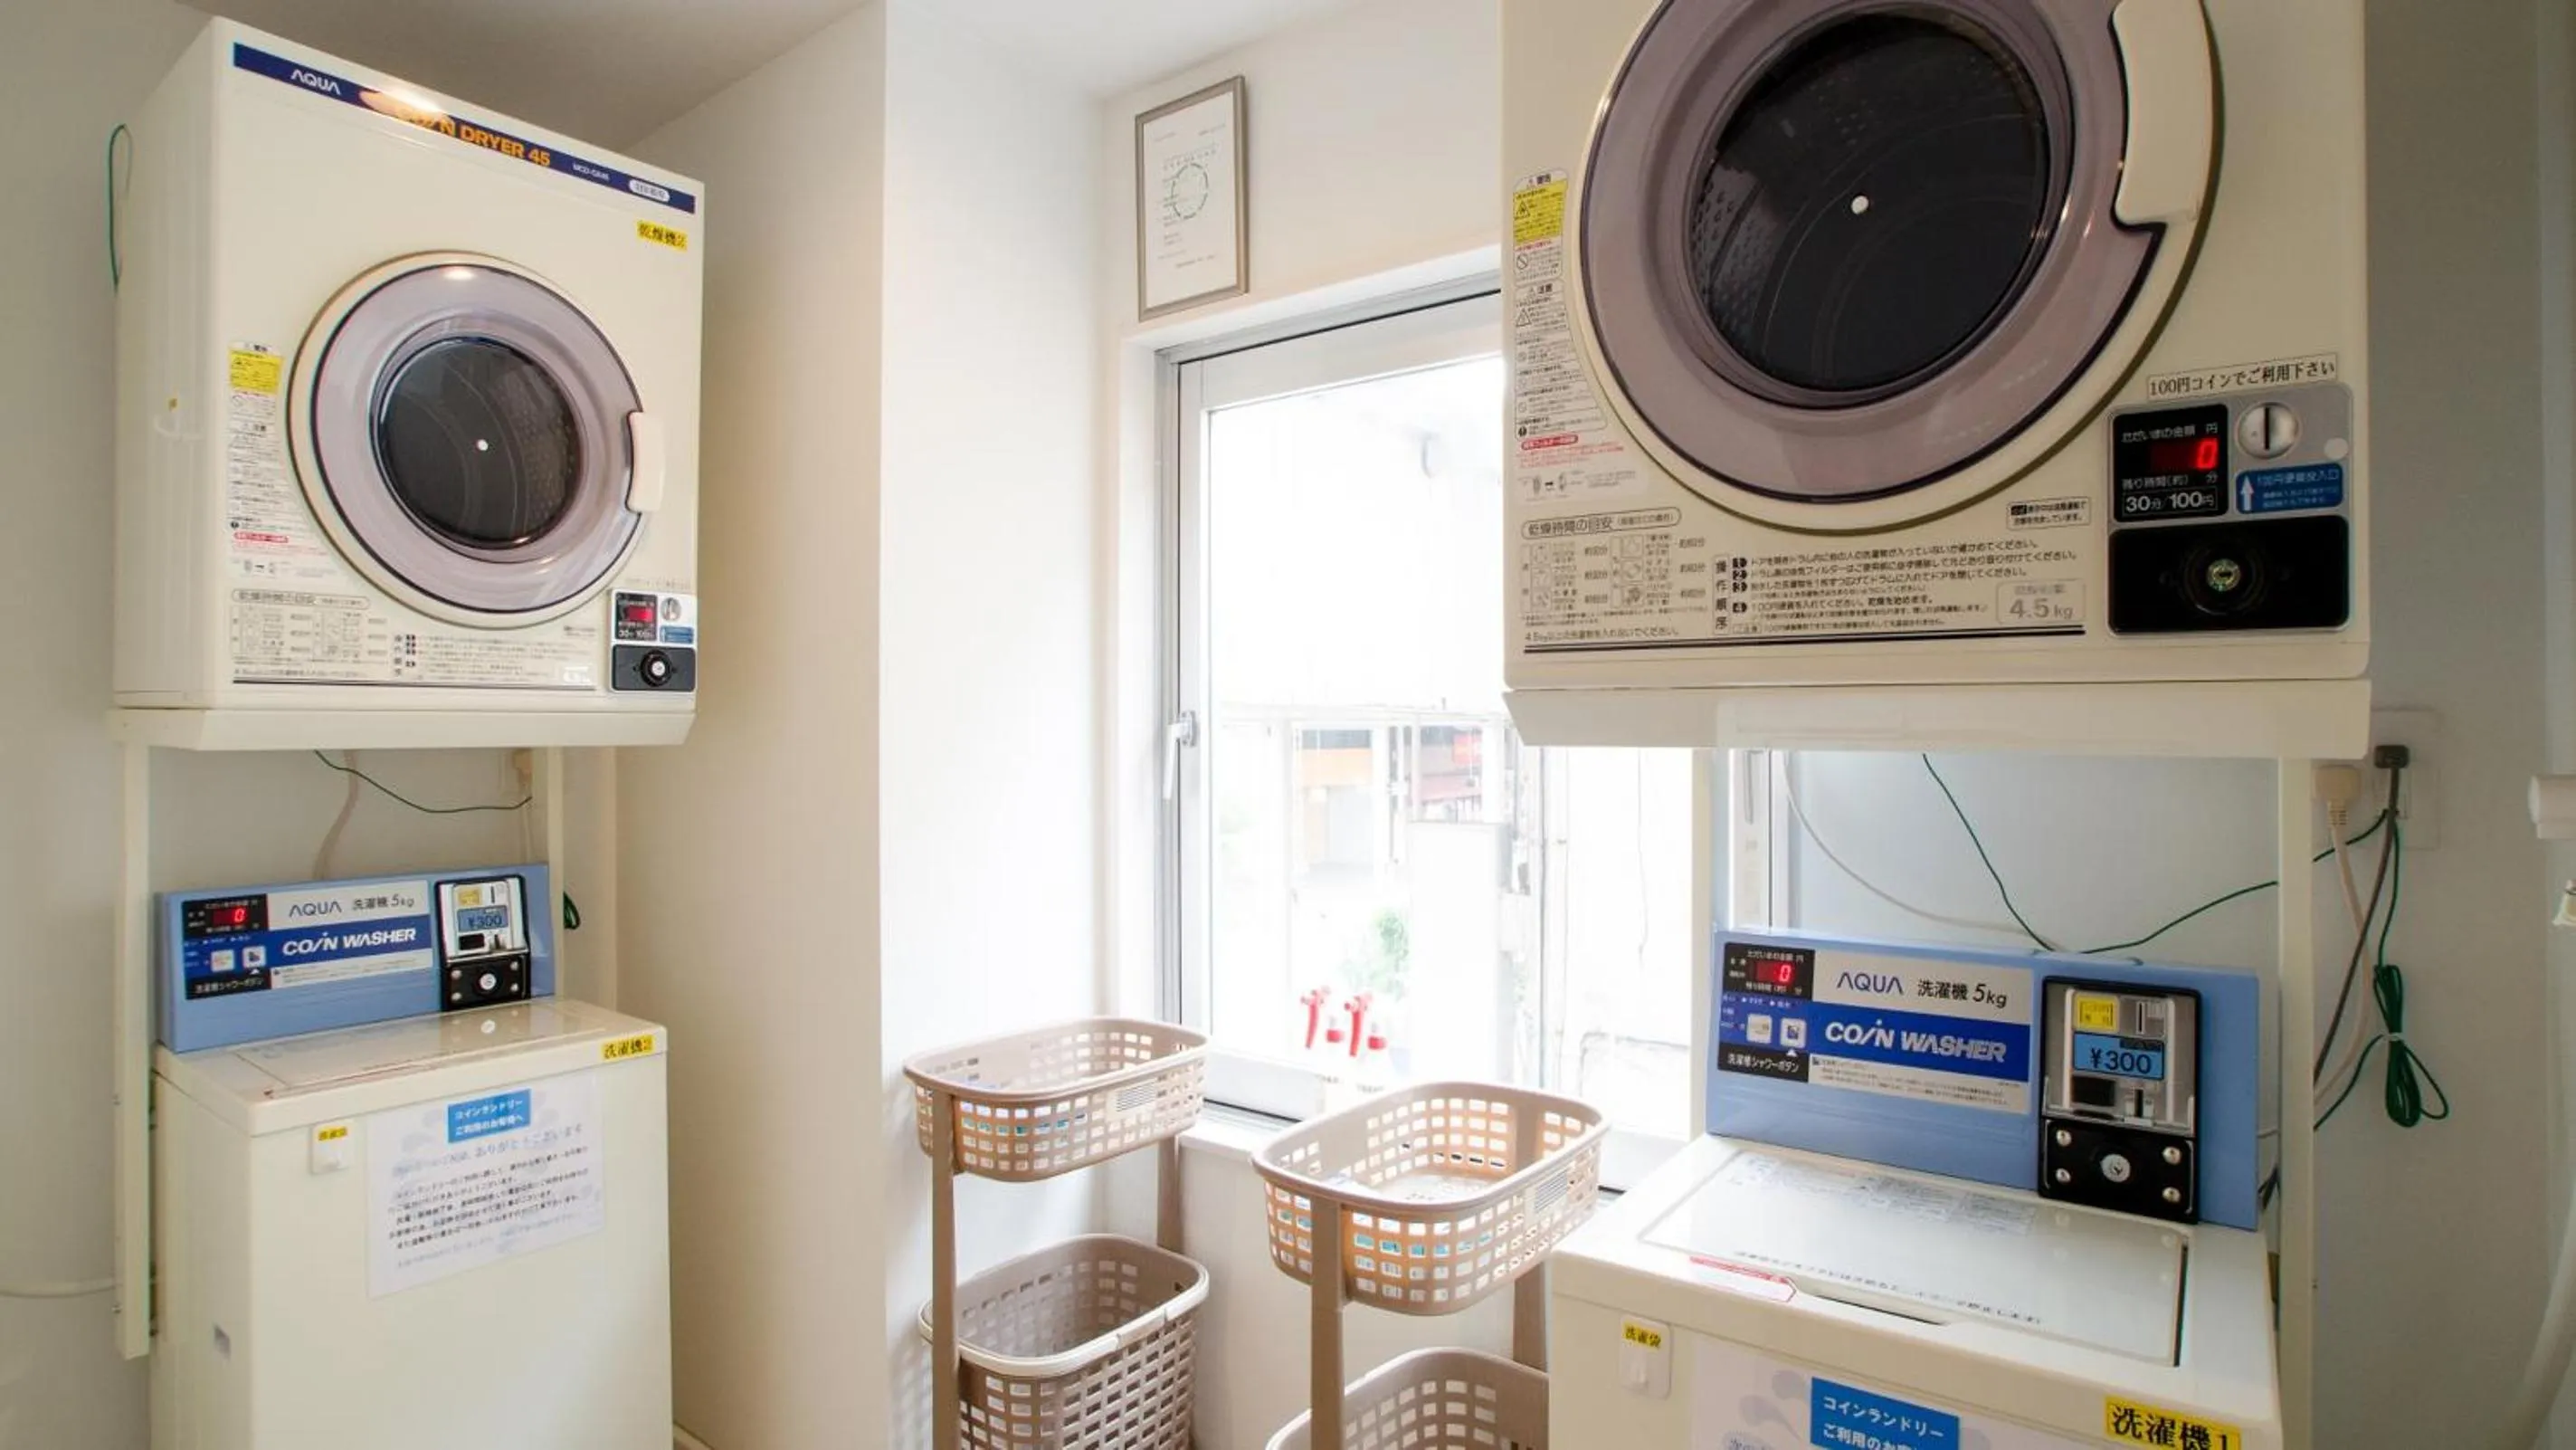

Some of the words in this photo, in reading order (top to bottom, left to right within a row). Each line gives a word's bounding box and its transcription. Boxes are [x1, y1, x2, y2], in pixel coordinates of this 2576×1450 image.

[290, 69, 341, 95] AQUA
[460, 125, 525, 158] DRYER
[528, 149, 551, 167] 45
[2150, 361, 2335, 397] 100円コインでご利用下さい
[2205, 422, 2219, 434] 円
[2196, 437, 2219, 469] 0
[233, 907, 245, 922] 0
[289, 901, 342, 918] AQUA
[467, 914, 502, 929] ¥300
[343, 927, 417, 950] WASHER
[1779, 964, 1792, 983] 0
[1837, 971, 1904, 996] AQUA
[1917, 978, 1968, 1000] 洗濯機
[1972, 983, 2007, 1009] 5kg
[1901, 1031, 2007, 1064] WASHER
[2090, 1047, 2152, 1074] ¥300
[1822, 1396, 1944, 1438] コインランドリー
